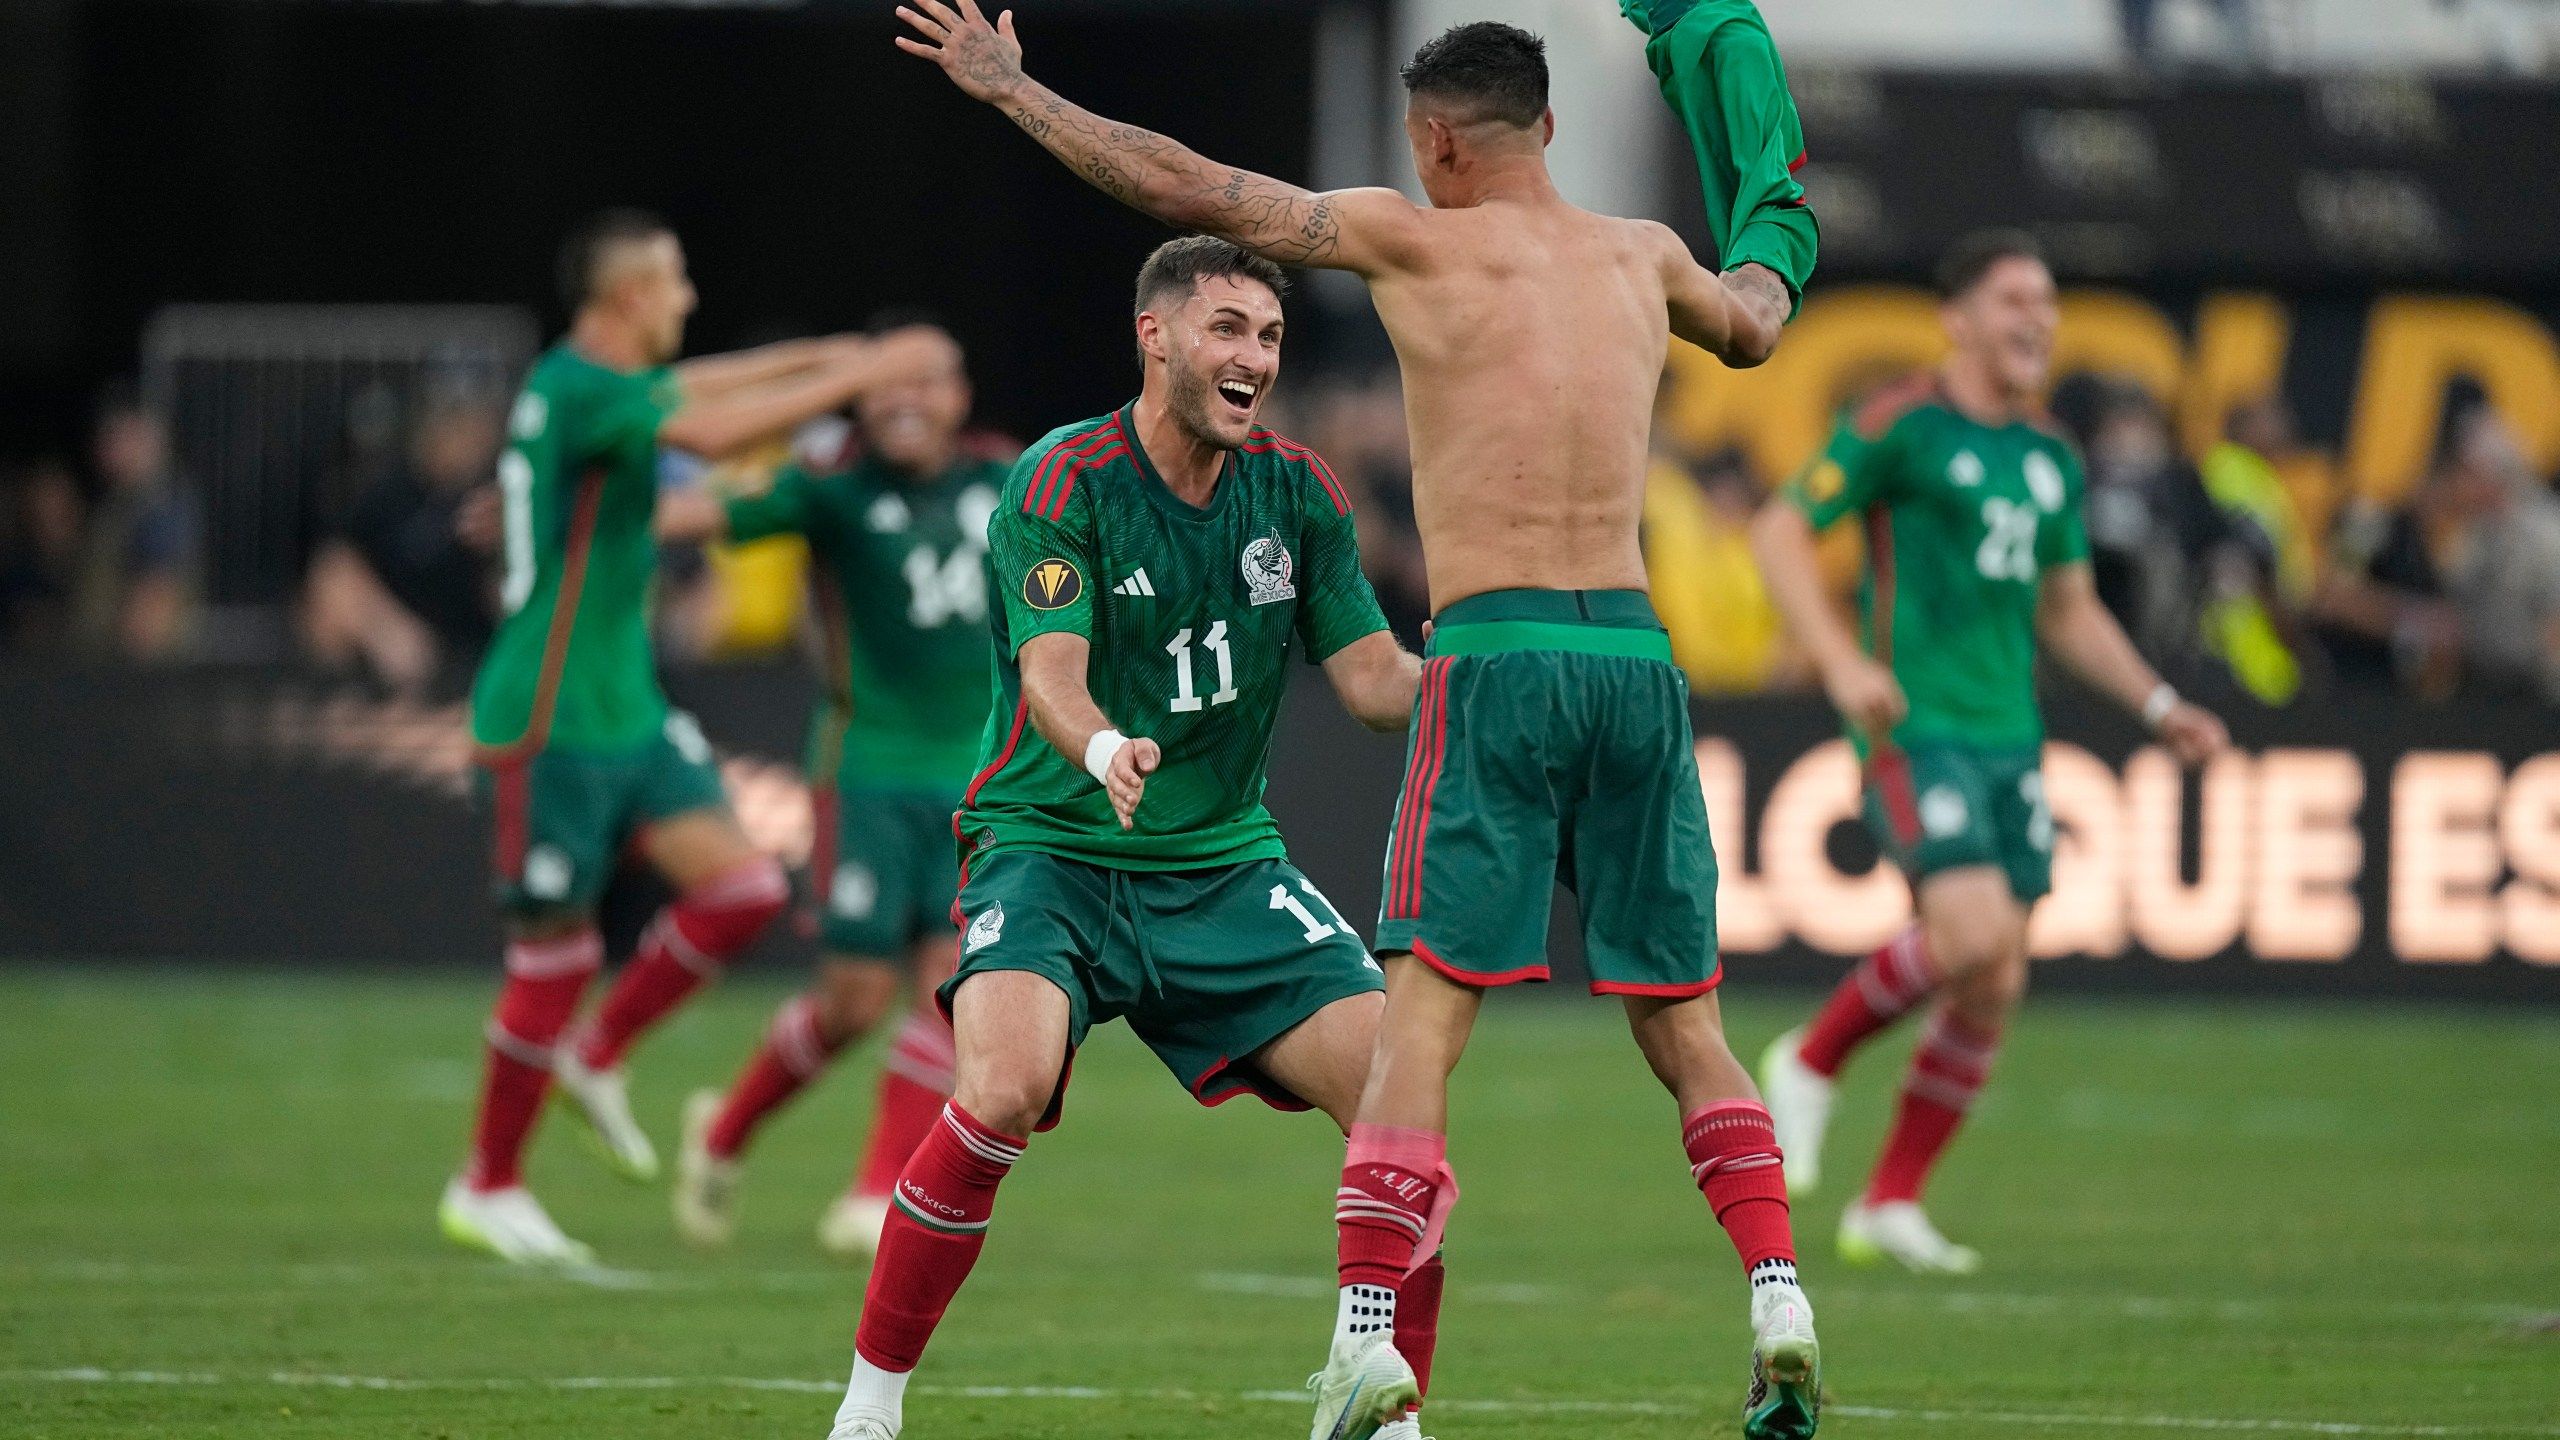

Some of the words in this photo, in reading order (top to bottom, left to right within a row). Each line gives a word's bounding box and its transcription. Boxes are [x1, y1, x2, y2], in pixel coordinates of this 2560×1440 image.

[1013, 107, 1051, 139] 2001
[1085, 157, 1124, 195] 2020
[1166, 620, 1238, 713] 11
[1269, 878, 1359, 944] 11
